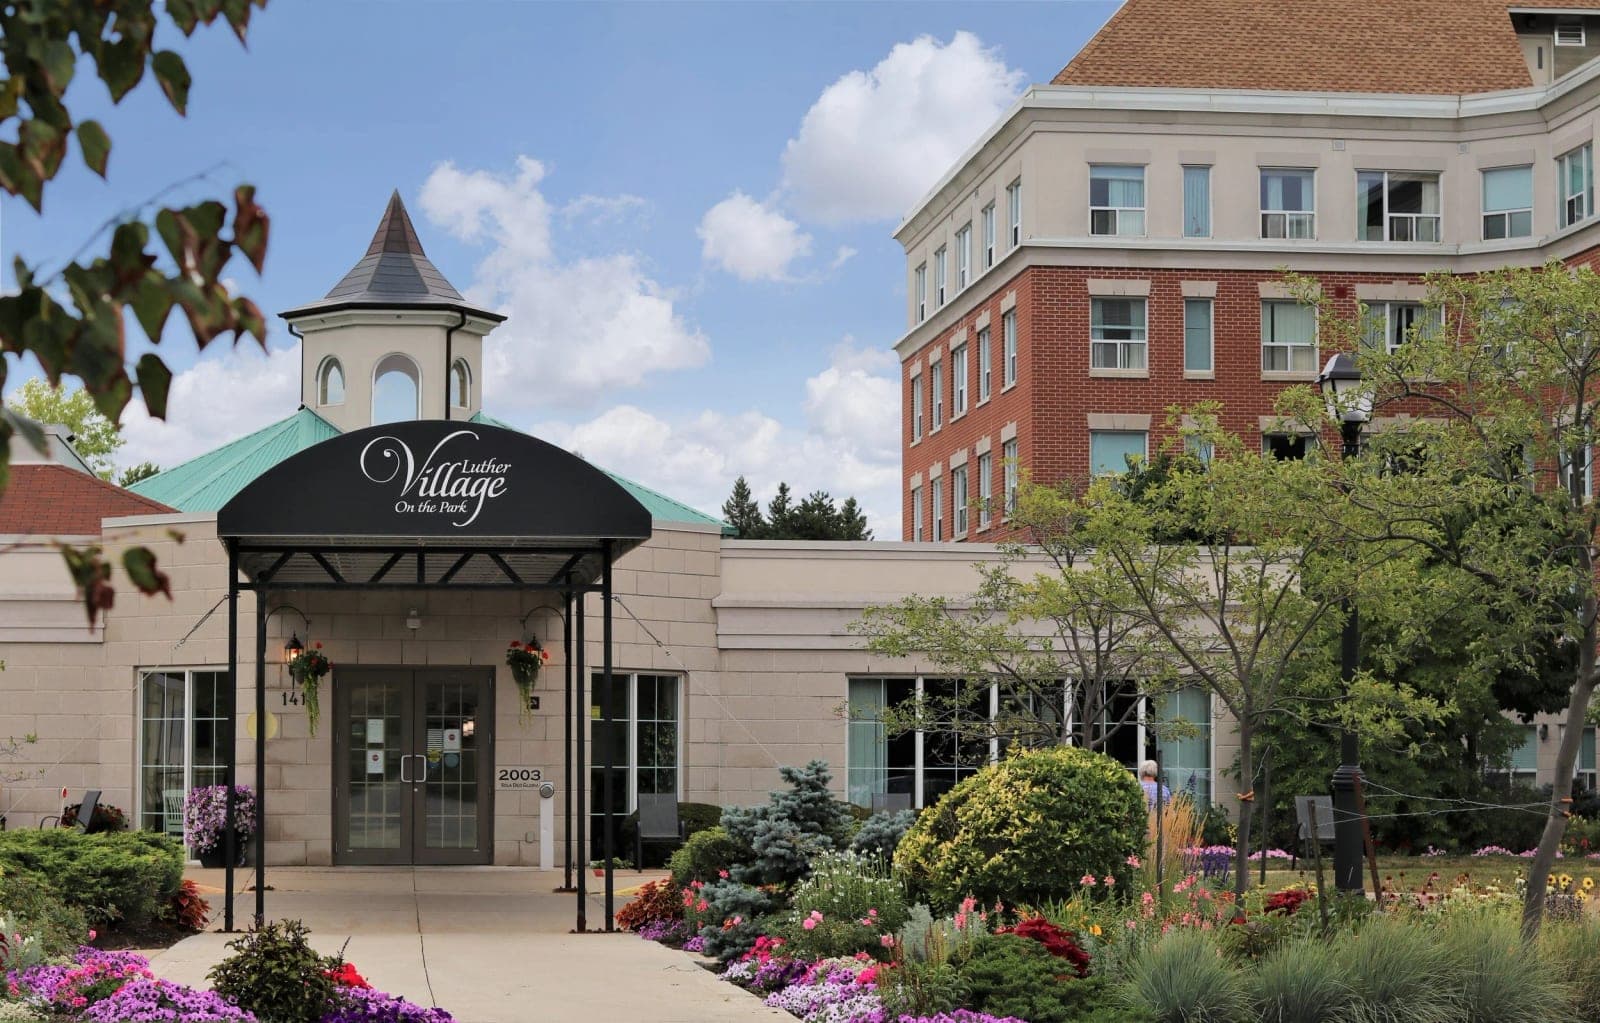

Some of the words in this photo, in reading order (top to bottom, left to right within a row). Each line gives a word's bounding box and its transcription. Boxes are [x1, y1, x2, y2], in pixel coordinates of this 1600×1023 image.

[461, 457, 512, 474] Luther
[360, 430, 508, 527] Village
[394, 500, 415, 513] On
[418, 499, 437, 513] the
[439, 499, 468, 513] Park
[498, 769, 541, 781] 2003
